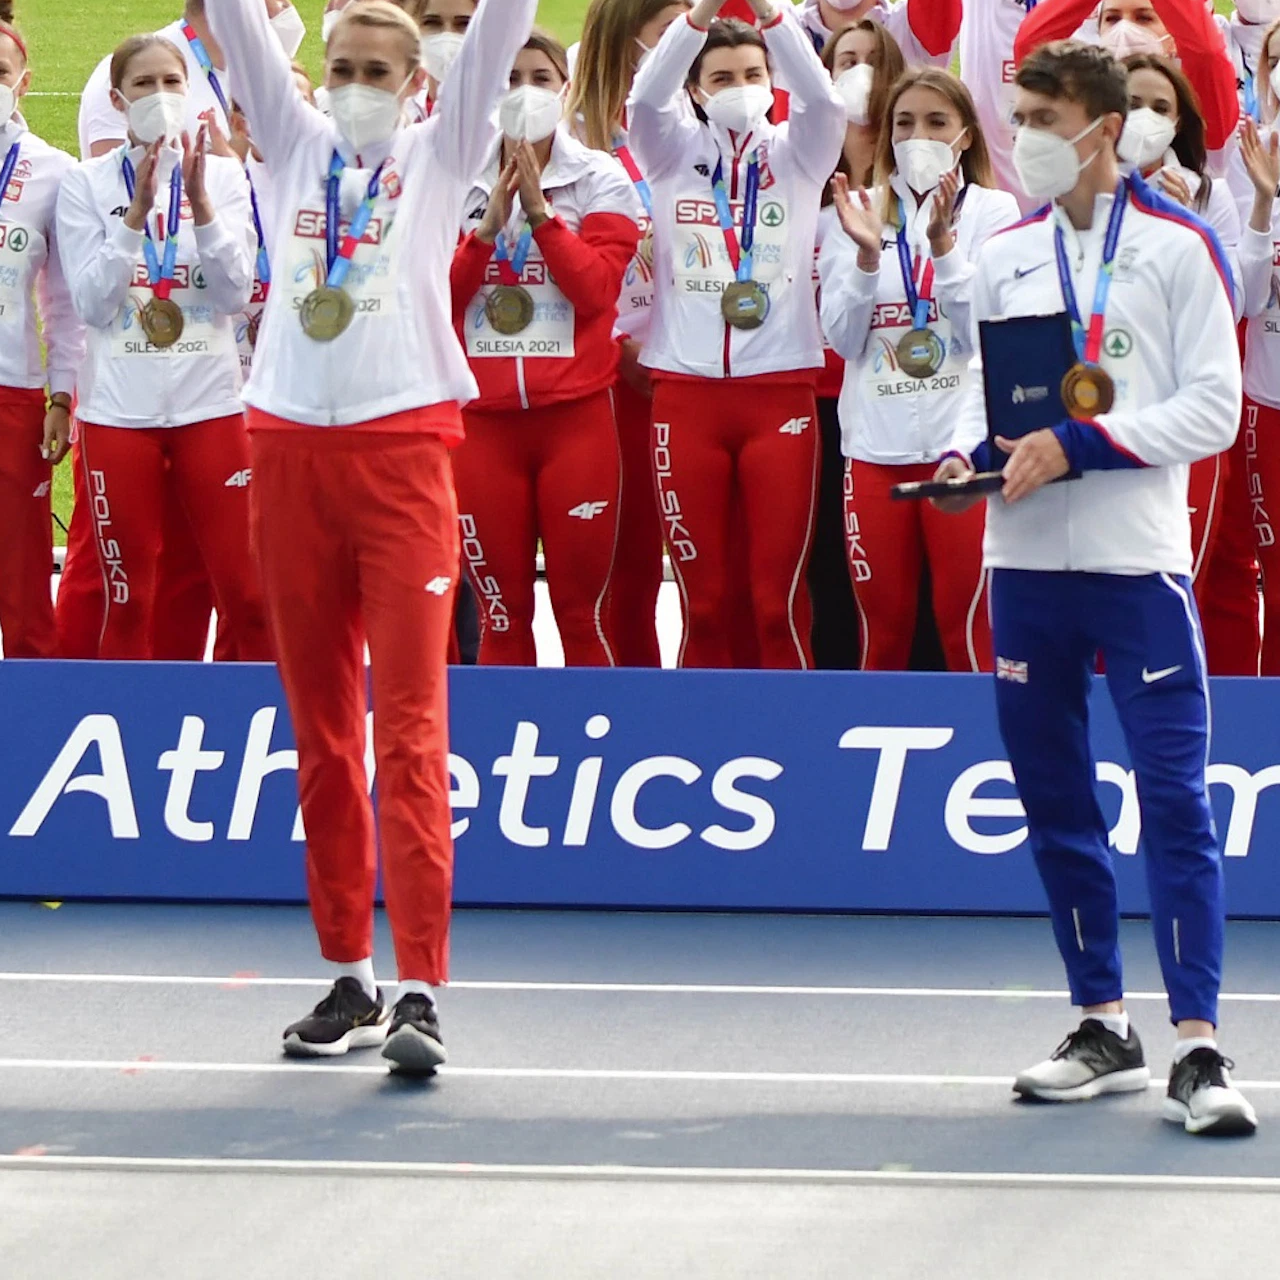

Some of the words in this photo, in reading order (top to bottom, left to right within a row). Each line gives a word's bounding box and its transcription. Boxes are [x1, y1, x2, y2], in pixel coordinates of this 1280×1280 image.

[177, 340, 209, 353] 2021
[475, 340, 525, 353] SILESIA
[529, 340, 561, 353] 2021
[876, 378, 929, 397] SILESIA
[931, 374, 961, 391] 2021
[778, 416, 812, 436] 4F
[1245, 404, 1276, 548] POLSKA
[653, 421, 698, 562] POLSKA
[568, 500, 609, 520] 4F
[89, 469, 130, 605] POLSKA
[457, 513, 510, 632] POLSKA
